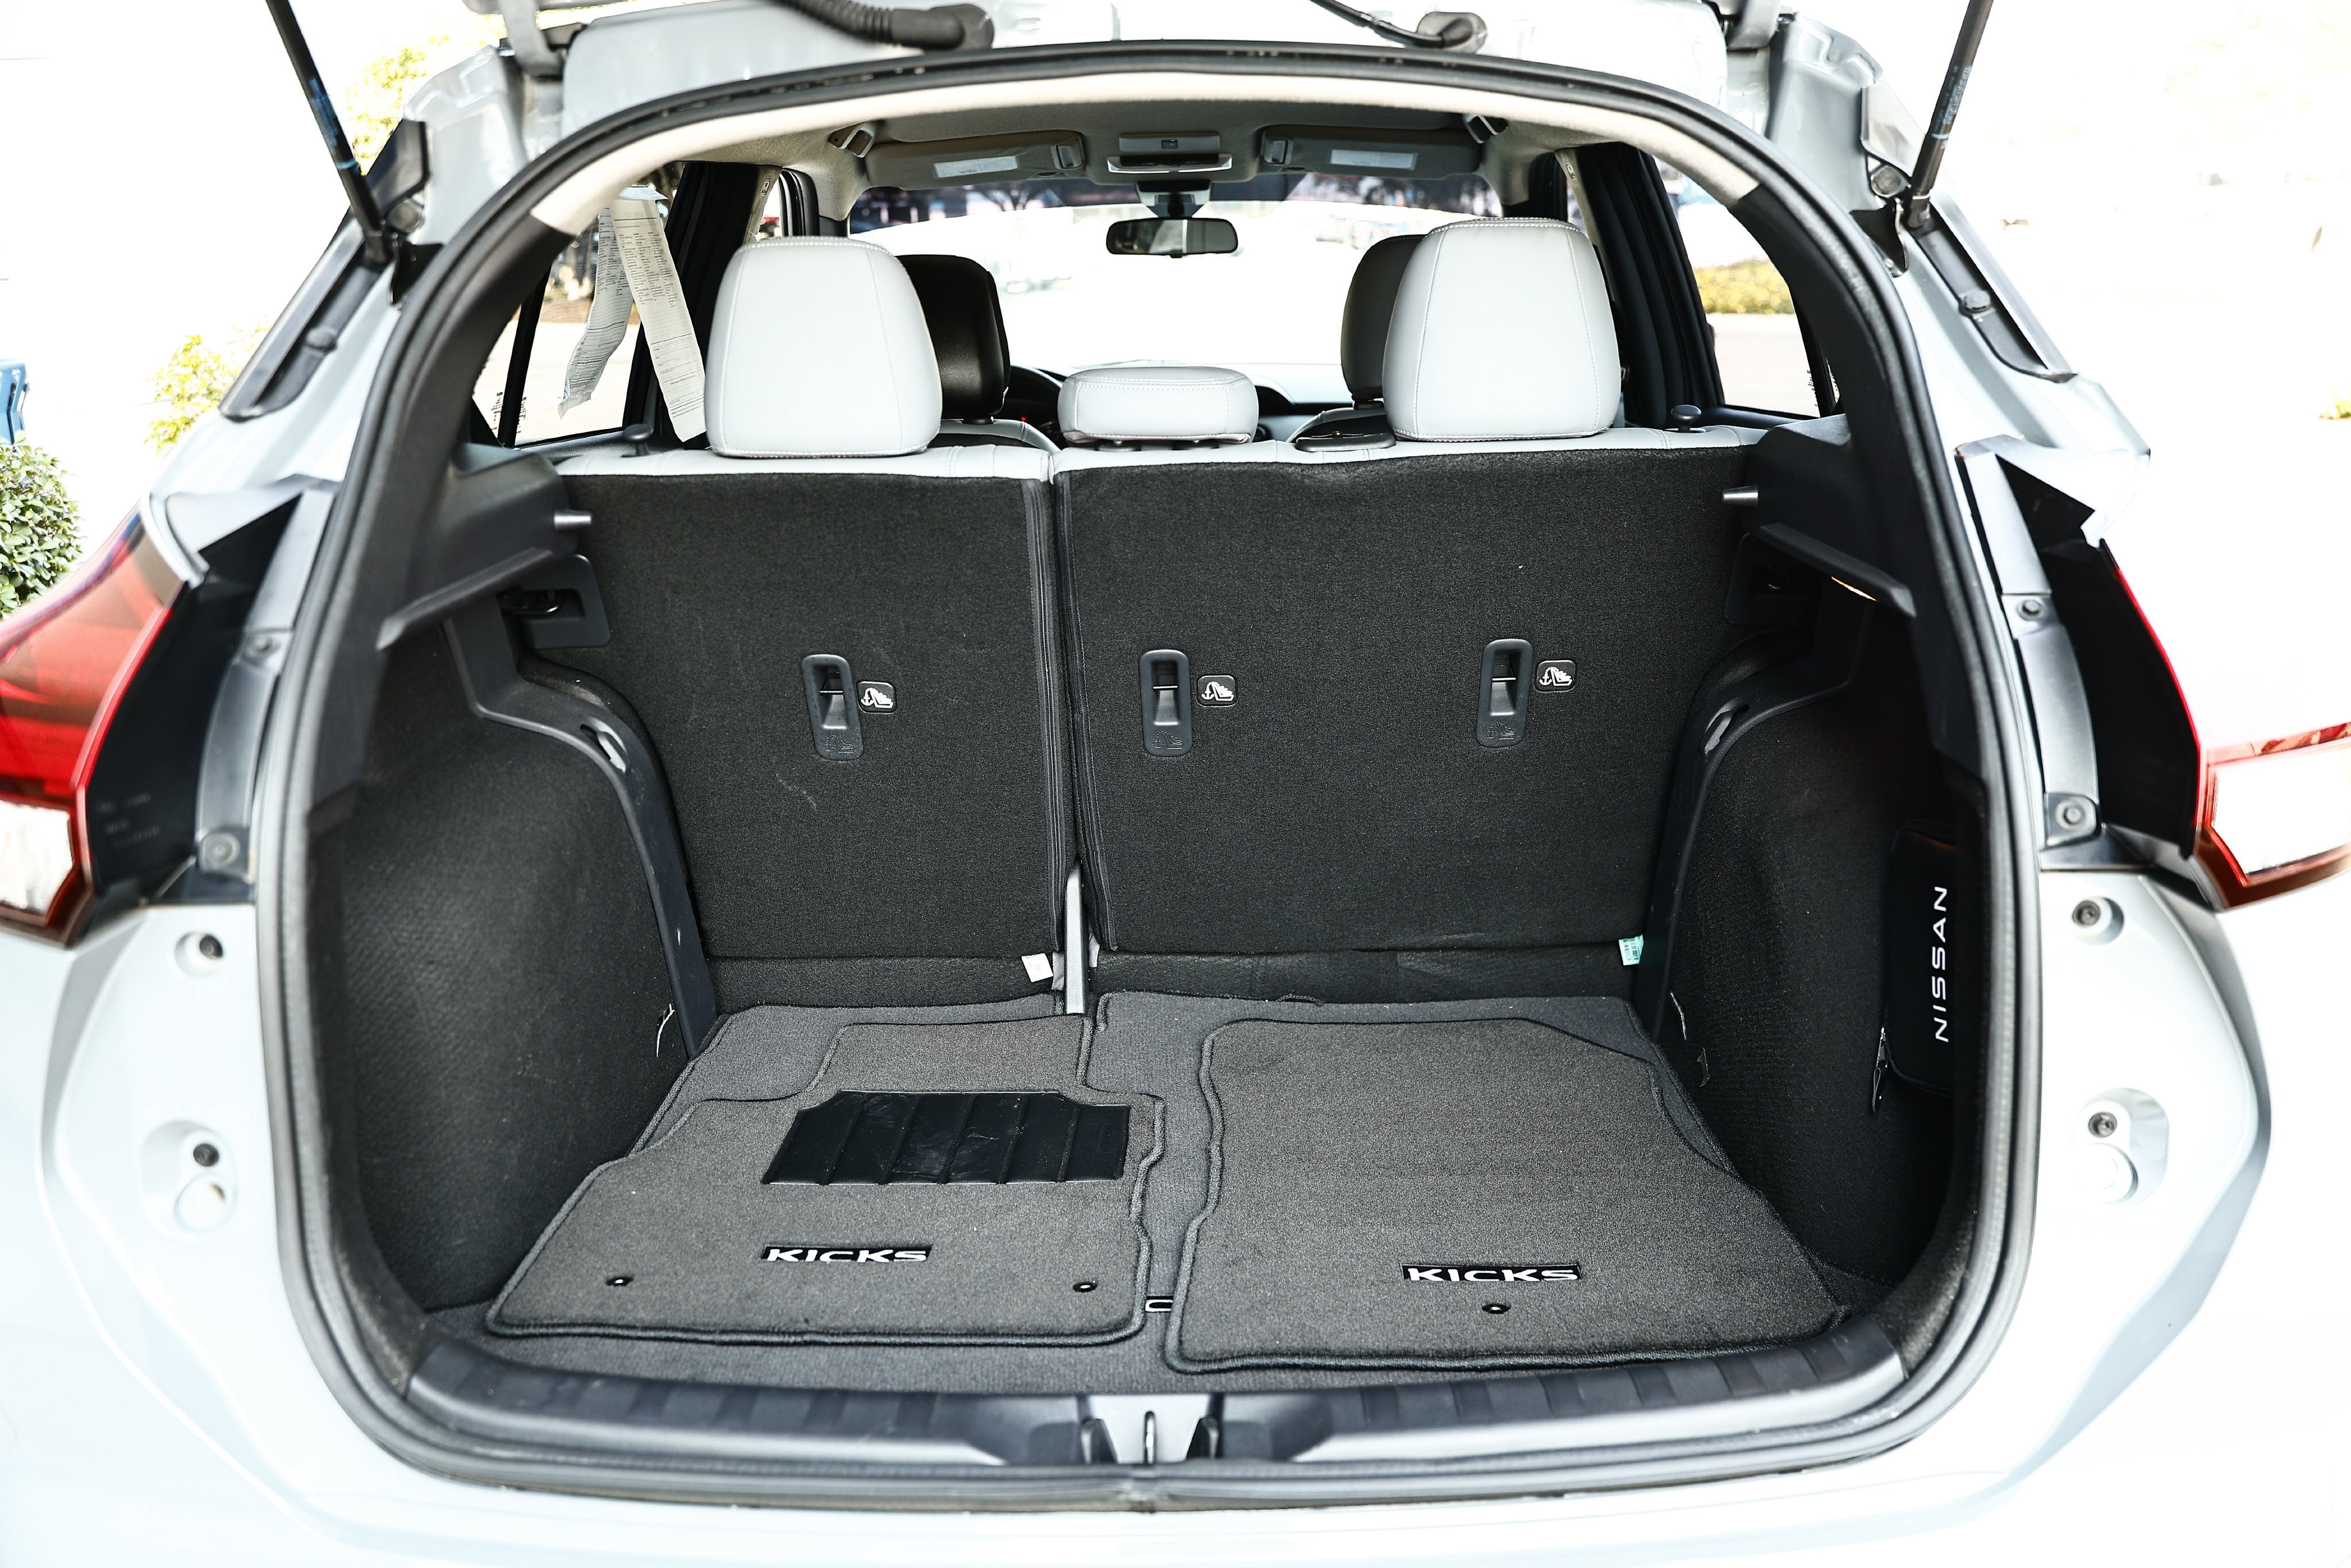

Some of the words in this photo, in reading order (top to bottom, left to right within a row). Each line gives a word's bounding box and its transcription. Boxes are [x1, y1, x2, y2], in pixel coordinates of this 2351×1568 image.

[1932, 887, 1949, 1043] NISSAN
[767, 1248, 927, 1263] KICKS
[1408, 1268, 1578, 1281] KICKS
